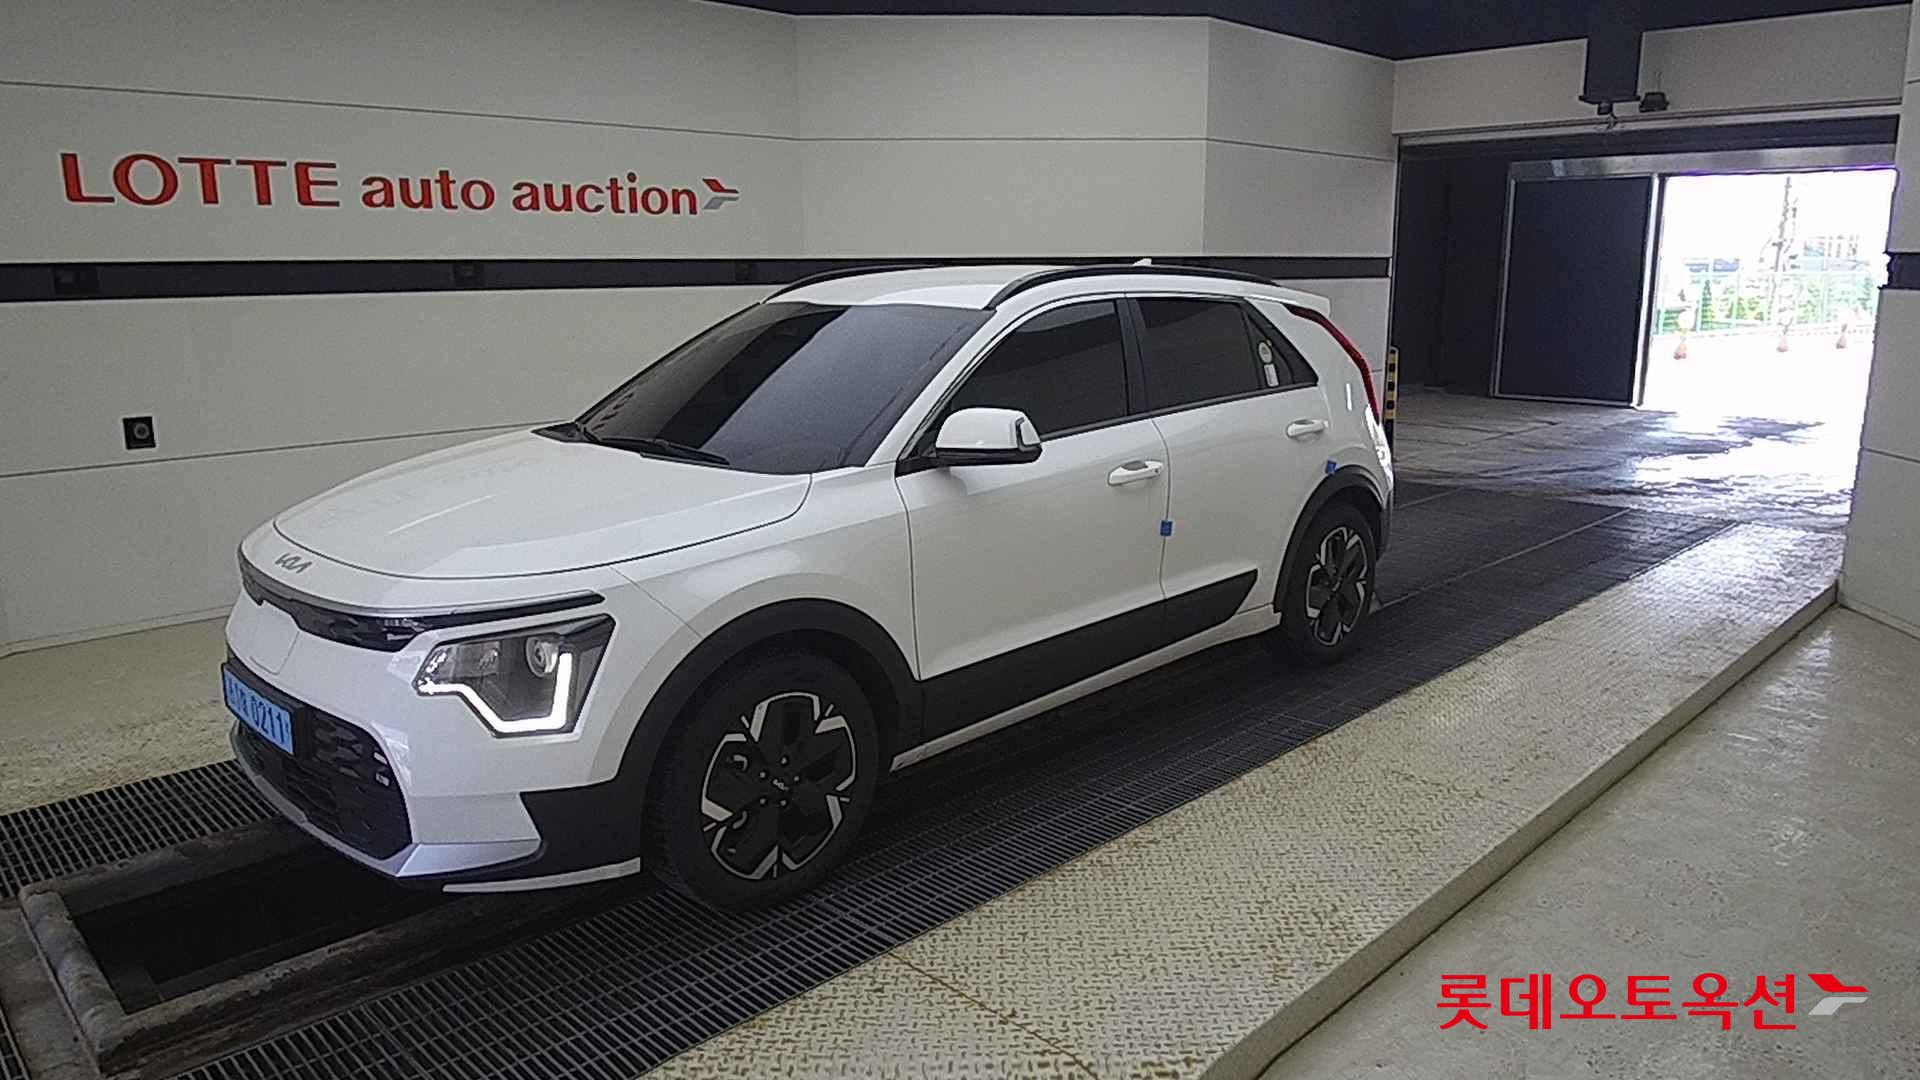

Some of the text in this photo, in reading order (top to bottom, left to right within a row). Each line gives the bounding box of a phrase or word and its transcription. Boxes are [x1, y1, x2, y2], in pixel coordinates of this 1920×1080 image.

[60, 152, 698, 216] LOTTE auto auction
